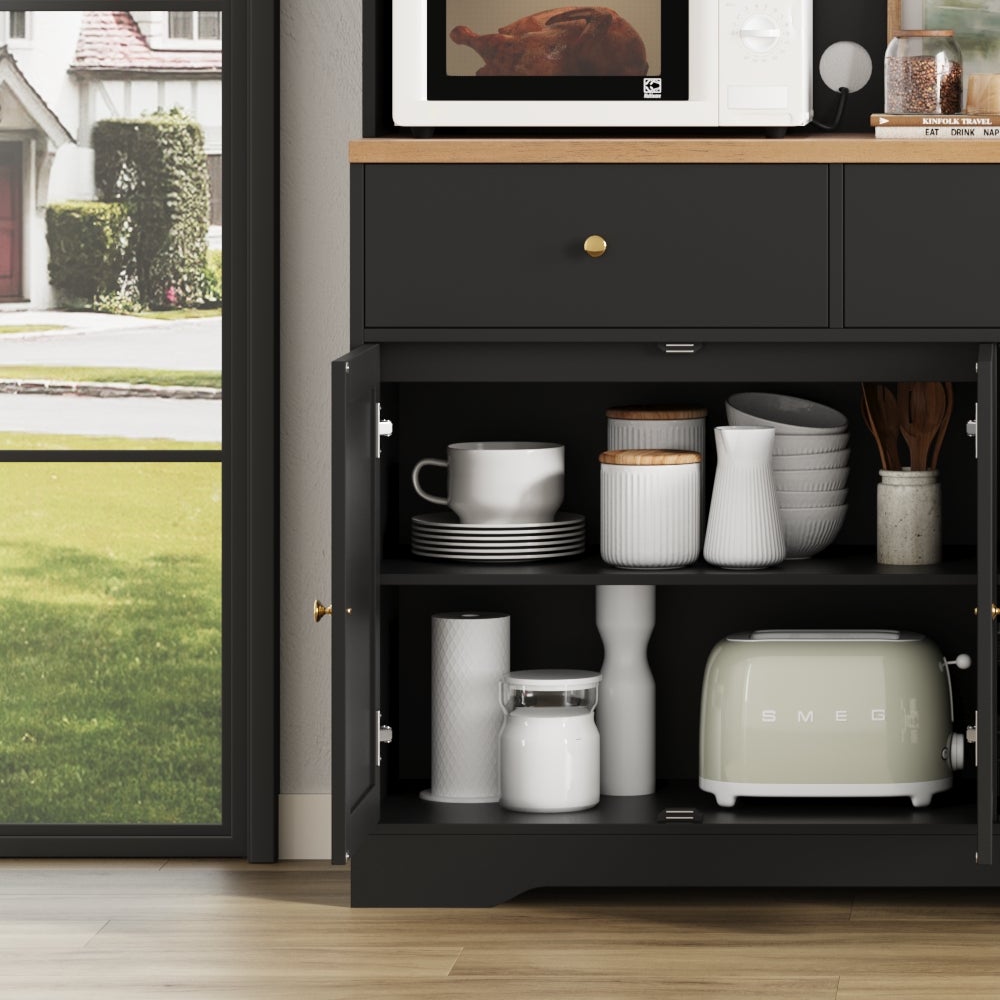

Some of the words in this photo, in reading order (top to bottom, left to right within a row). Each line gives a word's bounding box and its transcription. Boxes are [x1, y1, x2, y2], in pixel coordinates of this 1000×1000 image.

[922, 117, 960, 125] KINFOLK
[961, 117, 992, 125] TRAVEL
[925, 128, 940, 136] EAT
[951, 128, 975, 136] DRINK
[983, 128, 1000, 136] NAP
[761, 709, 886, 722] SMEG
